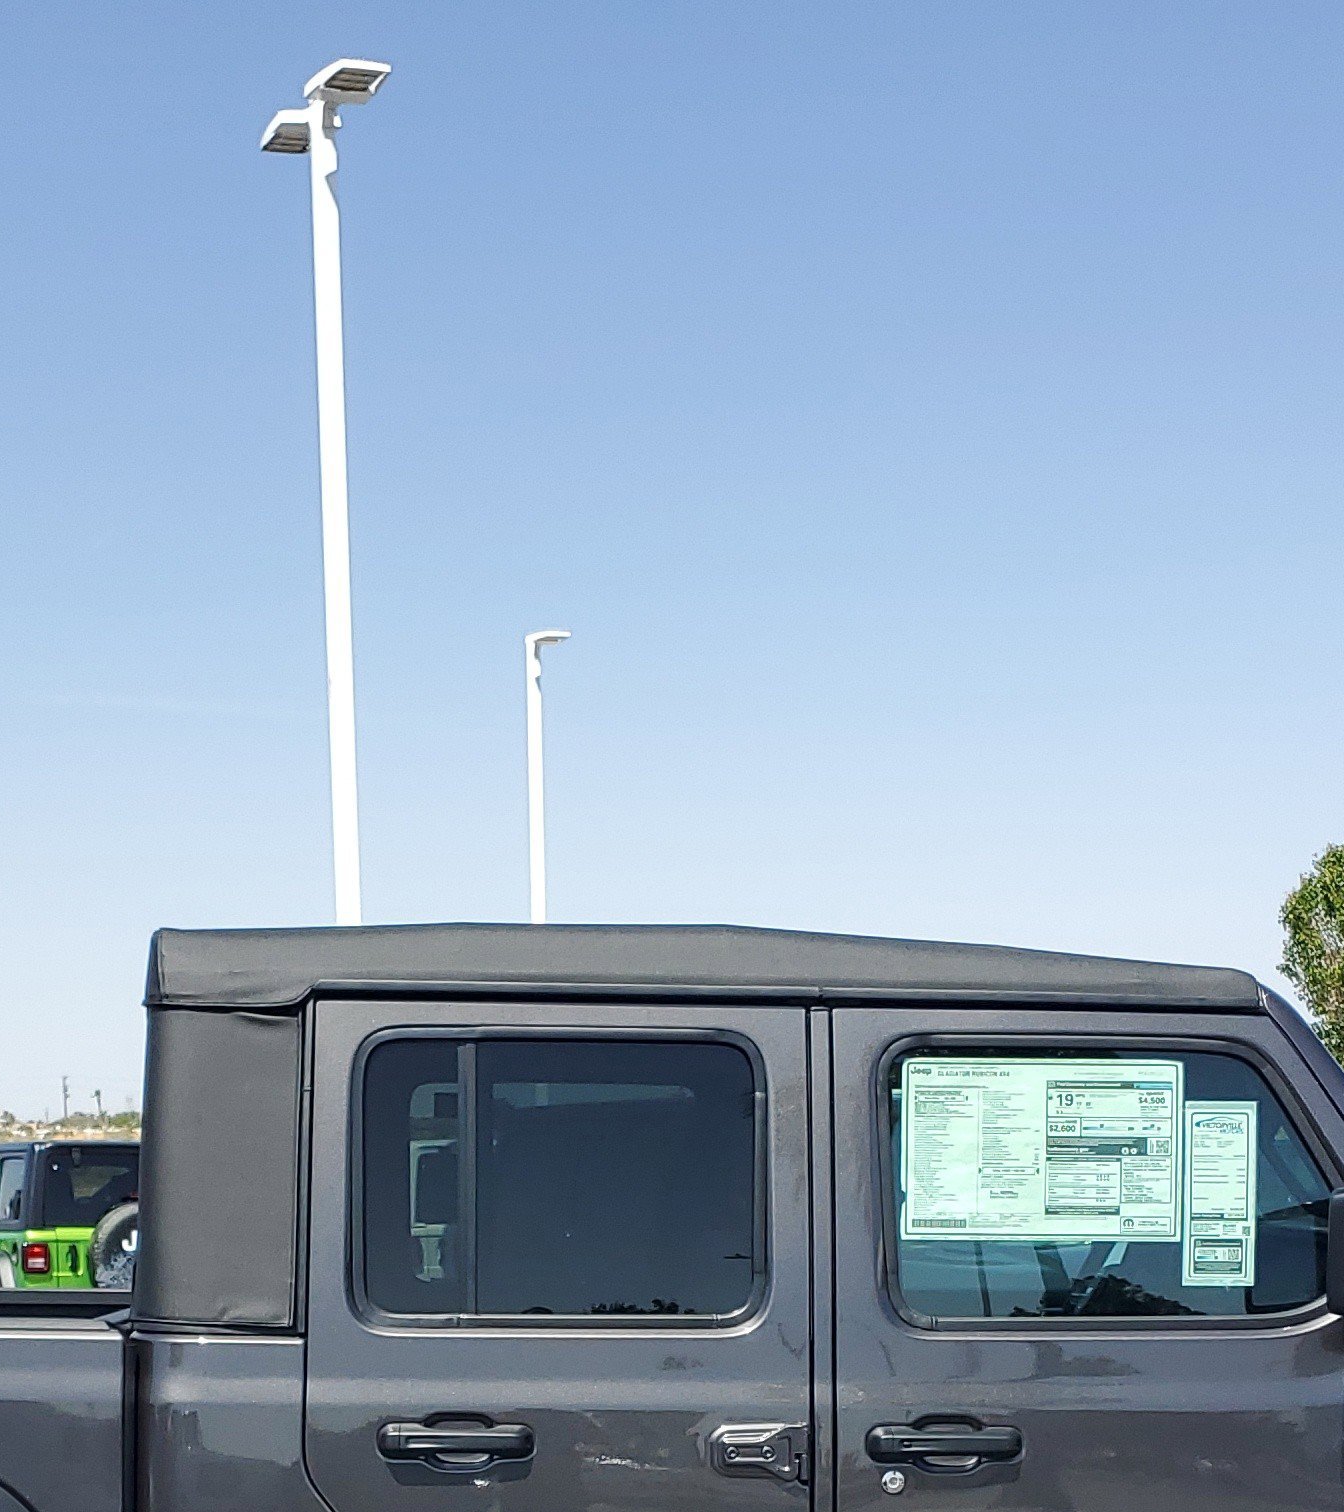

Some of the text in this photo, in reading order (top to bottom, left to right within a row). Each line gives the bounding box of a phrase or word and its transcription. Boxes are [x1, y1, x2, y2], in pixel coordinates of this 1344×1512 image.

[910, 1066, 932, 1076] Jeep
[1056, 1093, 1074, 1107] 19
[1138, 1096, 1166, 1105] $4,500
